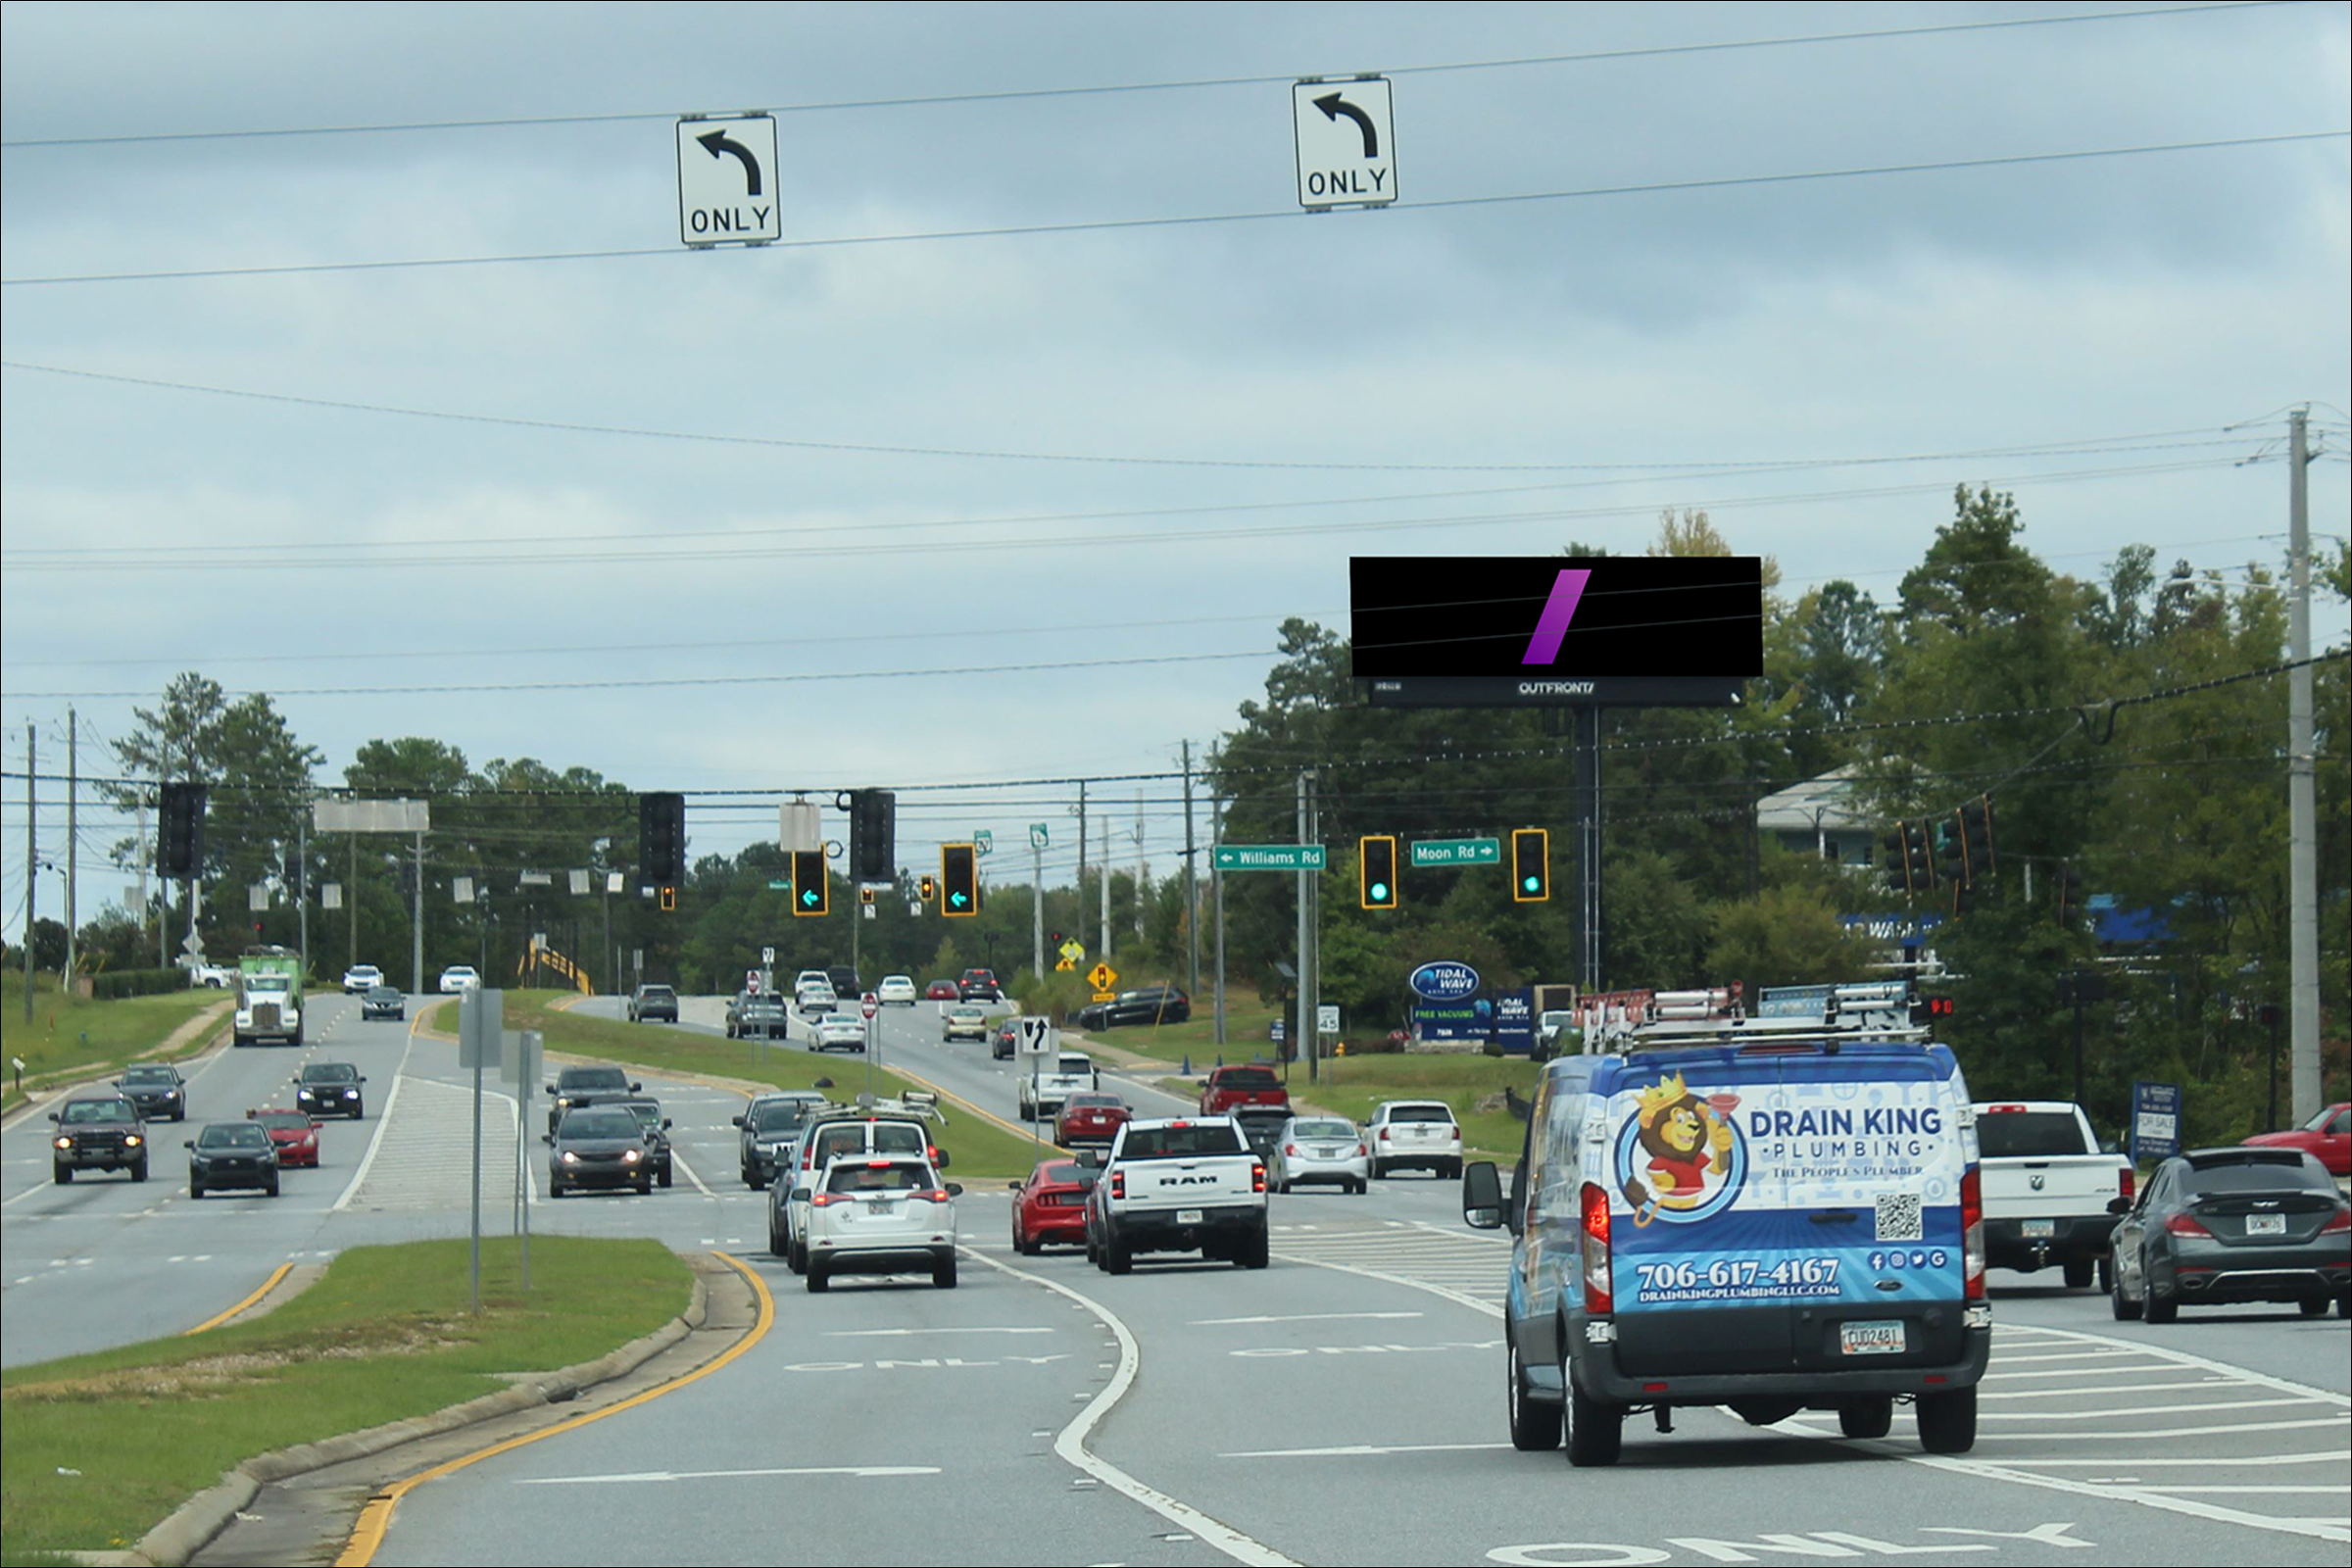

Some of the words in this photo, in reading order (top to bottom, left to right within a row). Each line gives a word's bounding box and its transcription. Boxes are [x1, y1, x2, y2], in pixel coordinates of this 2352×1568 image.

[1308, 168, 1388, 195] ONLY
[691, 206, 771, 233] ONLY
[1240, 851, 1296, 864] Williams
[1301, 851, 1320, 864] Rd
[1416, 847, 1451, 859] Moon
[1457, 846, 1475, 858] Rd
[1435, 968, 1467, 978] TIDAL
[1440, 978, 1474, 989] WAVE
[1415, 1009, 1436, 1018] FREE
[1438, 1009, 1475, 1018] VACUUMS
[1500, 1006, 1529, 1015] WAVE
[1319, 1019, 1338, 1030] 45
[1750, 1109, 1853, 1137] DRAIN
[1863, 1107, 1941, 1135] KING
[1159, 1175, 1218, 1186] RAM
[1638, 1258, 1840, 1290] 706-617-4167
[1639, 1285, 1840, 1302] DRAINKINGPLUMBINGLLC.COM
[1229, 1340, 1507, 1357] ONLY
[783, 1354, 1074, 1371] ONLY
[1485, 1522, 2098, 1567] ONLY
